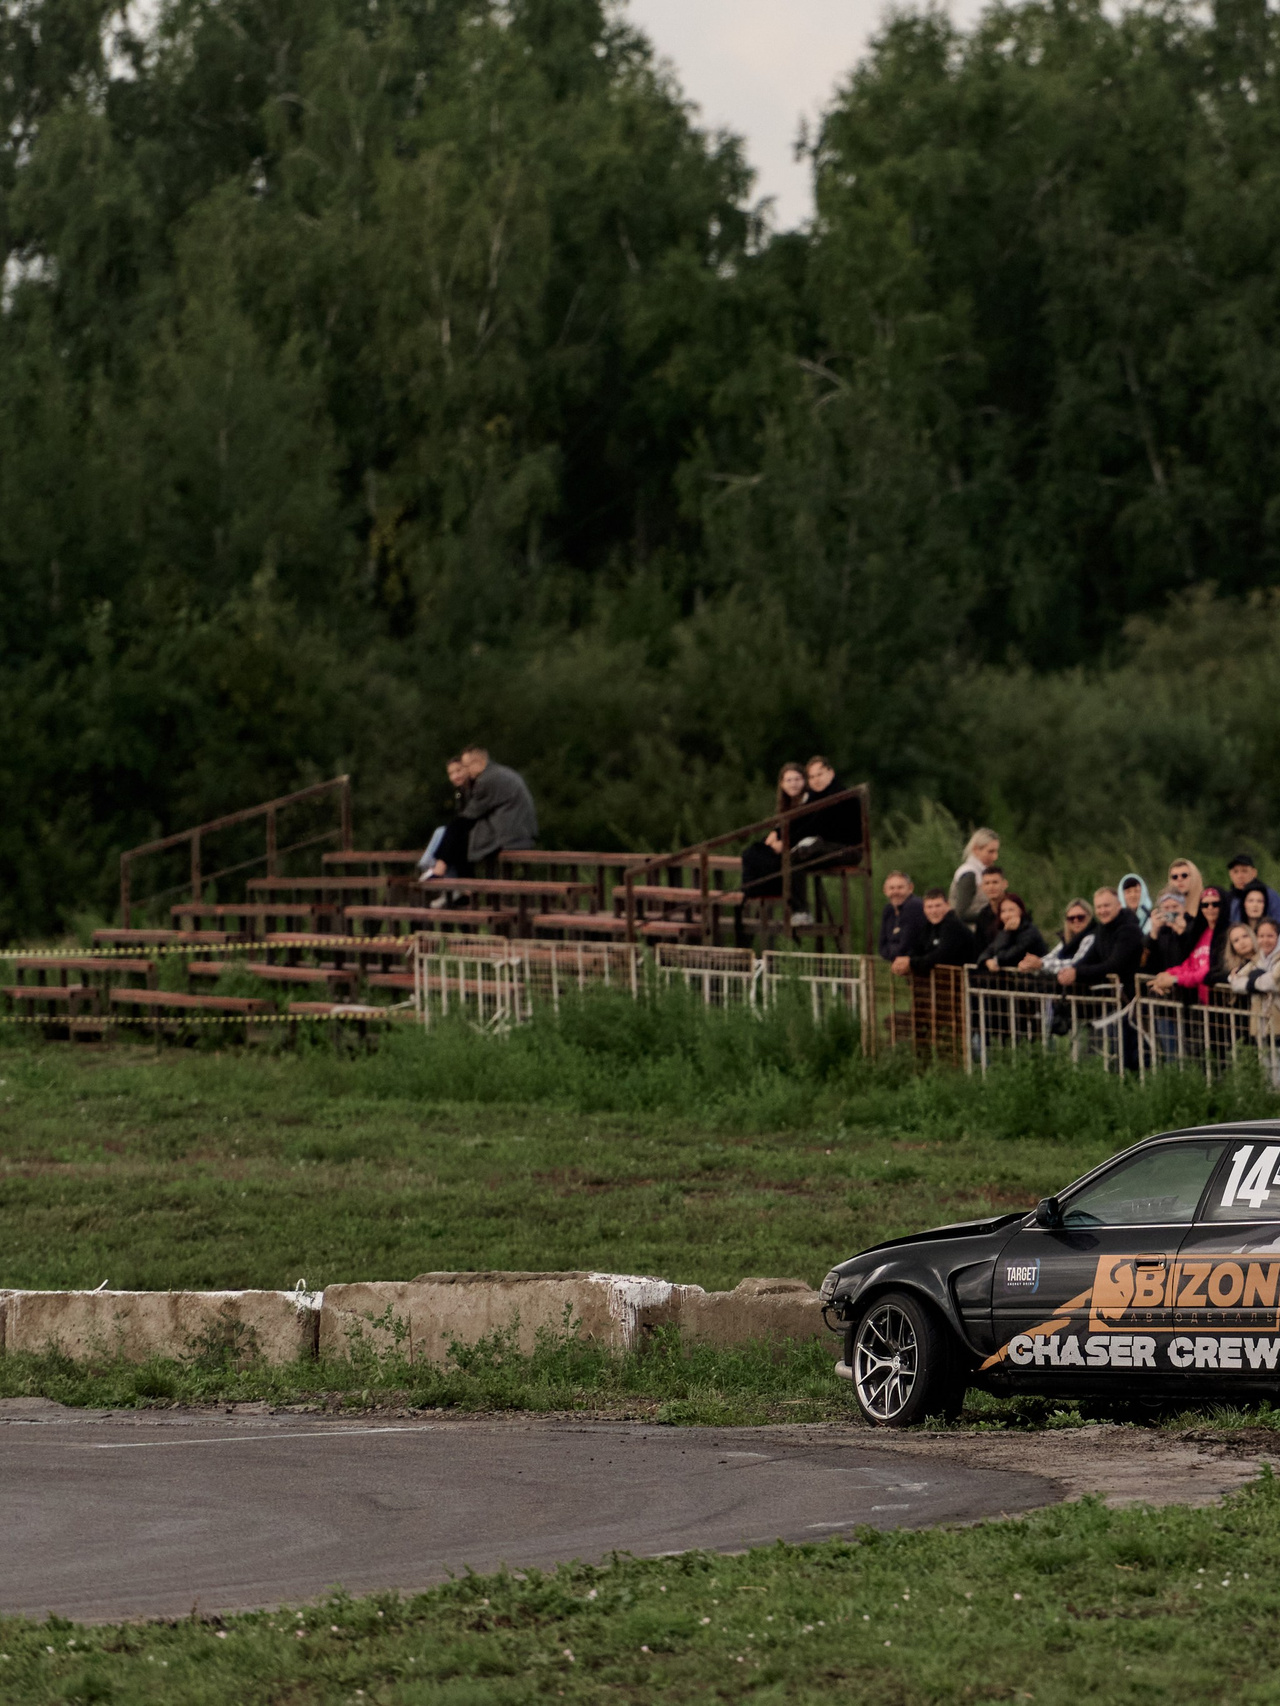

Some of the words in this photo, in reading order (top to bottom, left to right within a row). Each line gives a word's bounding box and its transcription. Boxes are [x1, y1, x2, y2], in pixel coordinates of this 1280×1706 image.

[1006, 1266, 1038, 1281] TARGET
[1130, 1312, 1273, 1325] АВТОДЕТАЛЬ
[1007, 1335, 1157, 1367] CHASER
